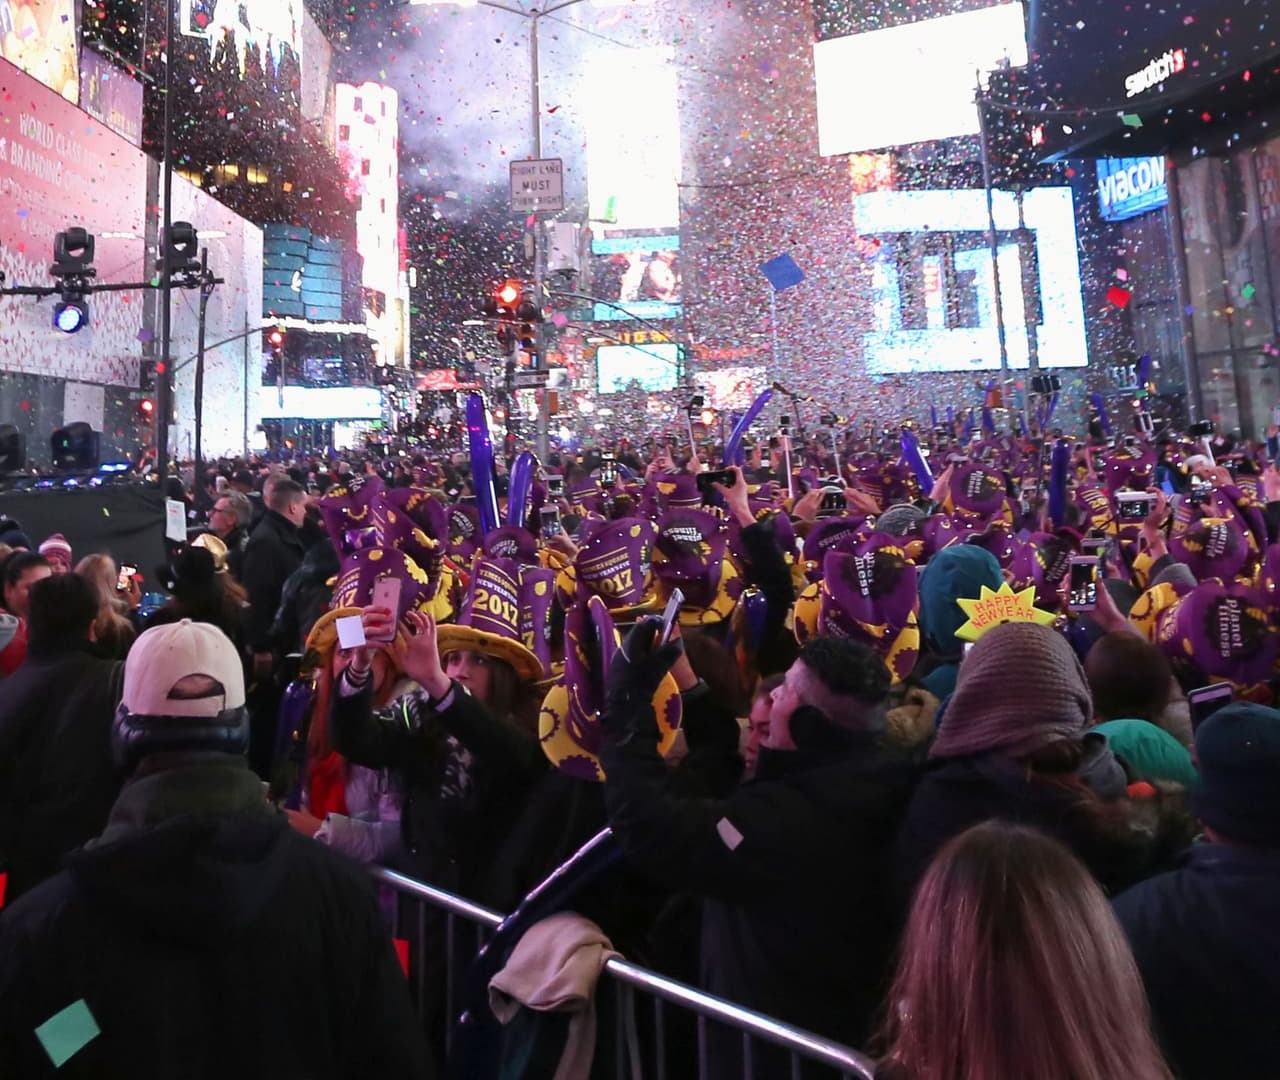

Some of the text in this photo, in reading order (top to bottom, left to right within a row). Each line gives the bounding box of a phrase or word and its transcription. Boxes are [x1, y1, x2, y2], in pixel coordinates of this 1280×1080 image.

[1125, 50, 1175, 98] swatch
[20, 112, 54, 149] WORLD
[10, 140, 62, 186] BRANDING
[522, 179, 551, 191] MUST
[472, 588, 518, 628] 2017
[975, 595, 1021, 613] HAPPY
[1225, 597, 1243, 648] planet
